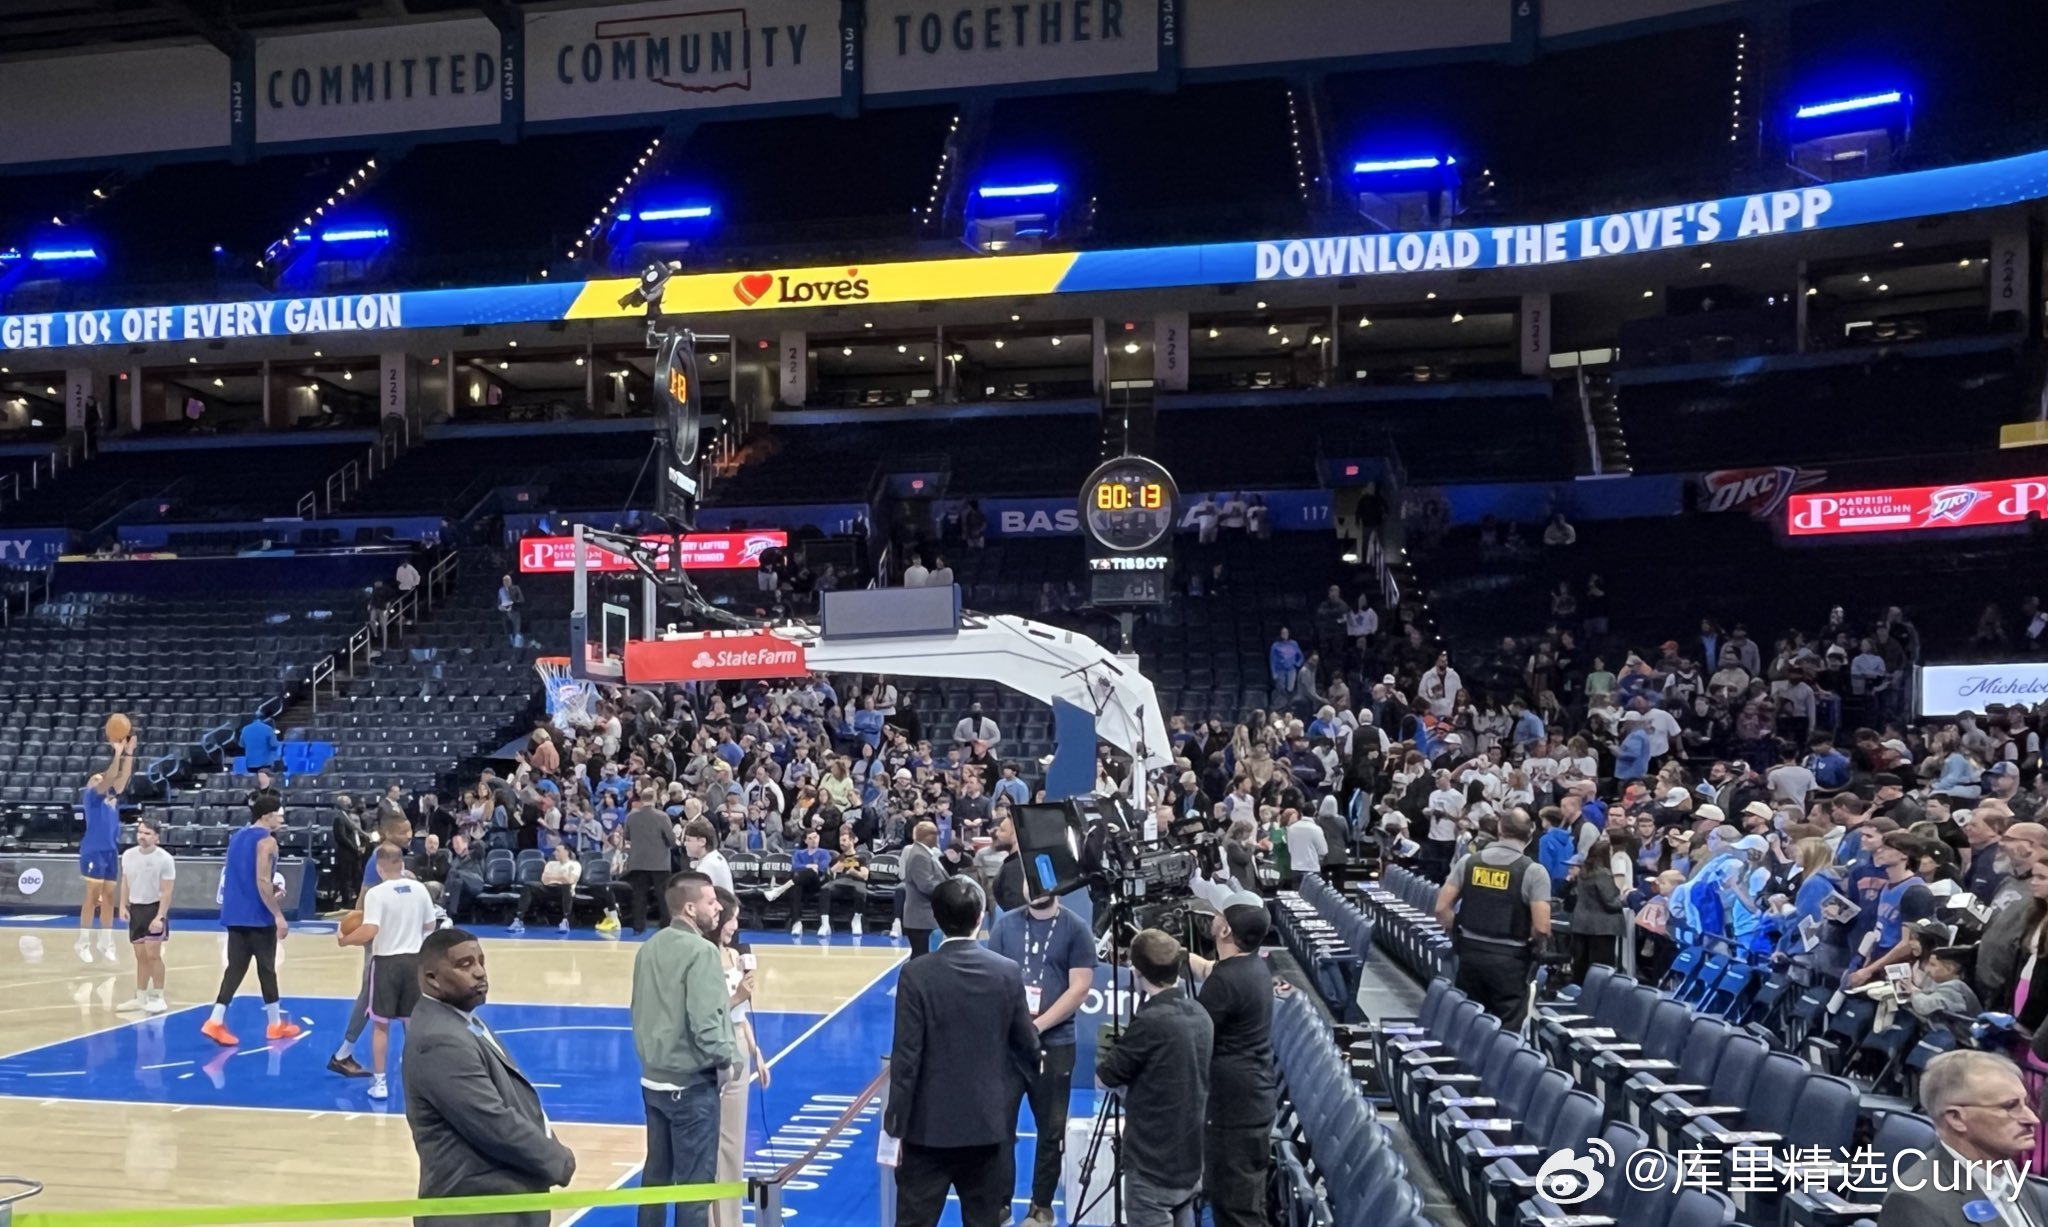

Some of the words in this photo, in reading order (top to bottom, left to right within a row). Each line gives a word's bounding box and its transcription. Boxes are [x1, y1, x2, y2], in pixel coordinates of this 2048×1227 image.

[894, 1, 1123, 56] TOGETHER
[557, 24, 807, 84] COMMUNITY
[268, 52, 495, 108] COMMITTED
[504, 57, 514, 101] 323
[1255, 231, 1480, 280] DOWNLOAD
[1492, 224, 1567, 265] THE
[1580, 202, 1721, 257] LOVE'S
[1737, 188, 1833, 238] APP
[2, 315, 53, 349] GET
[65, 311, 111, 345] 10¢
[121, 307, 173, 342] OFF
[184, 302, 275, 339] EVERY
[285, 294, 401, 333] GALLON
[1097, 484, 1161, 509] 80:13
[1839, 495, 1892, 505] PARRISH
[1302, 506, 1329, 521] 117
[1839, 504, 1911, 517] DEVAUGHN
[1111, 557, 1168, 570] TISSOT
[21, 876, 41, 885] abc
[1475, 869, 1507, 887] POLICE
